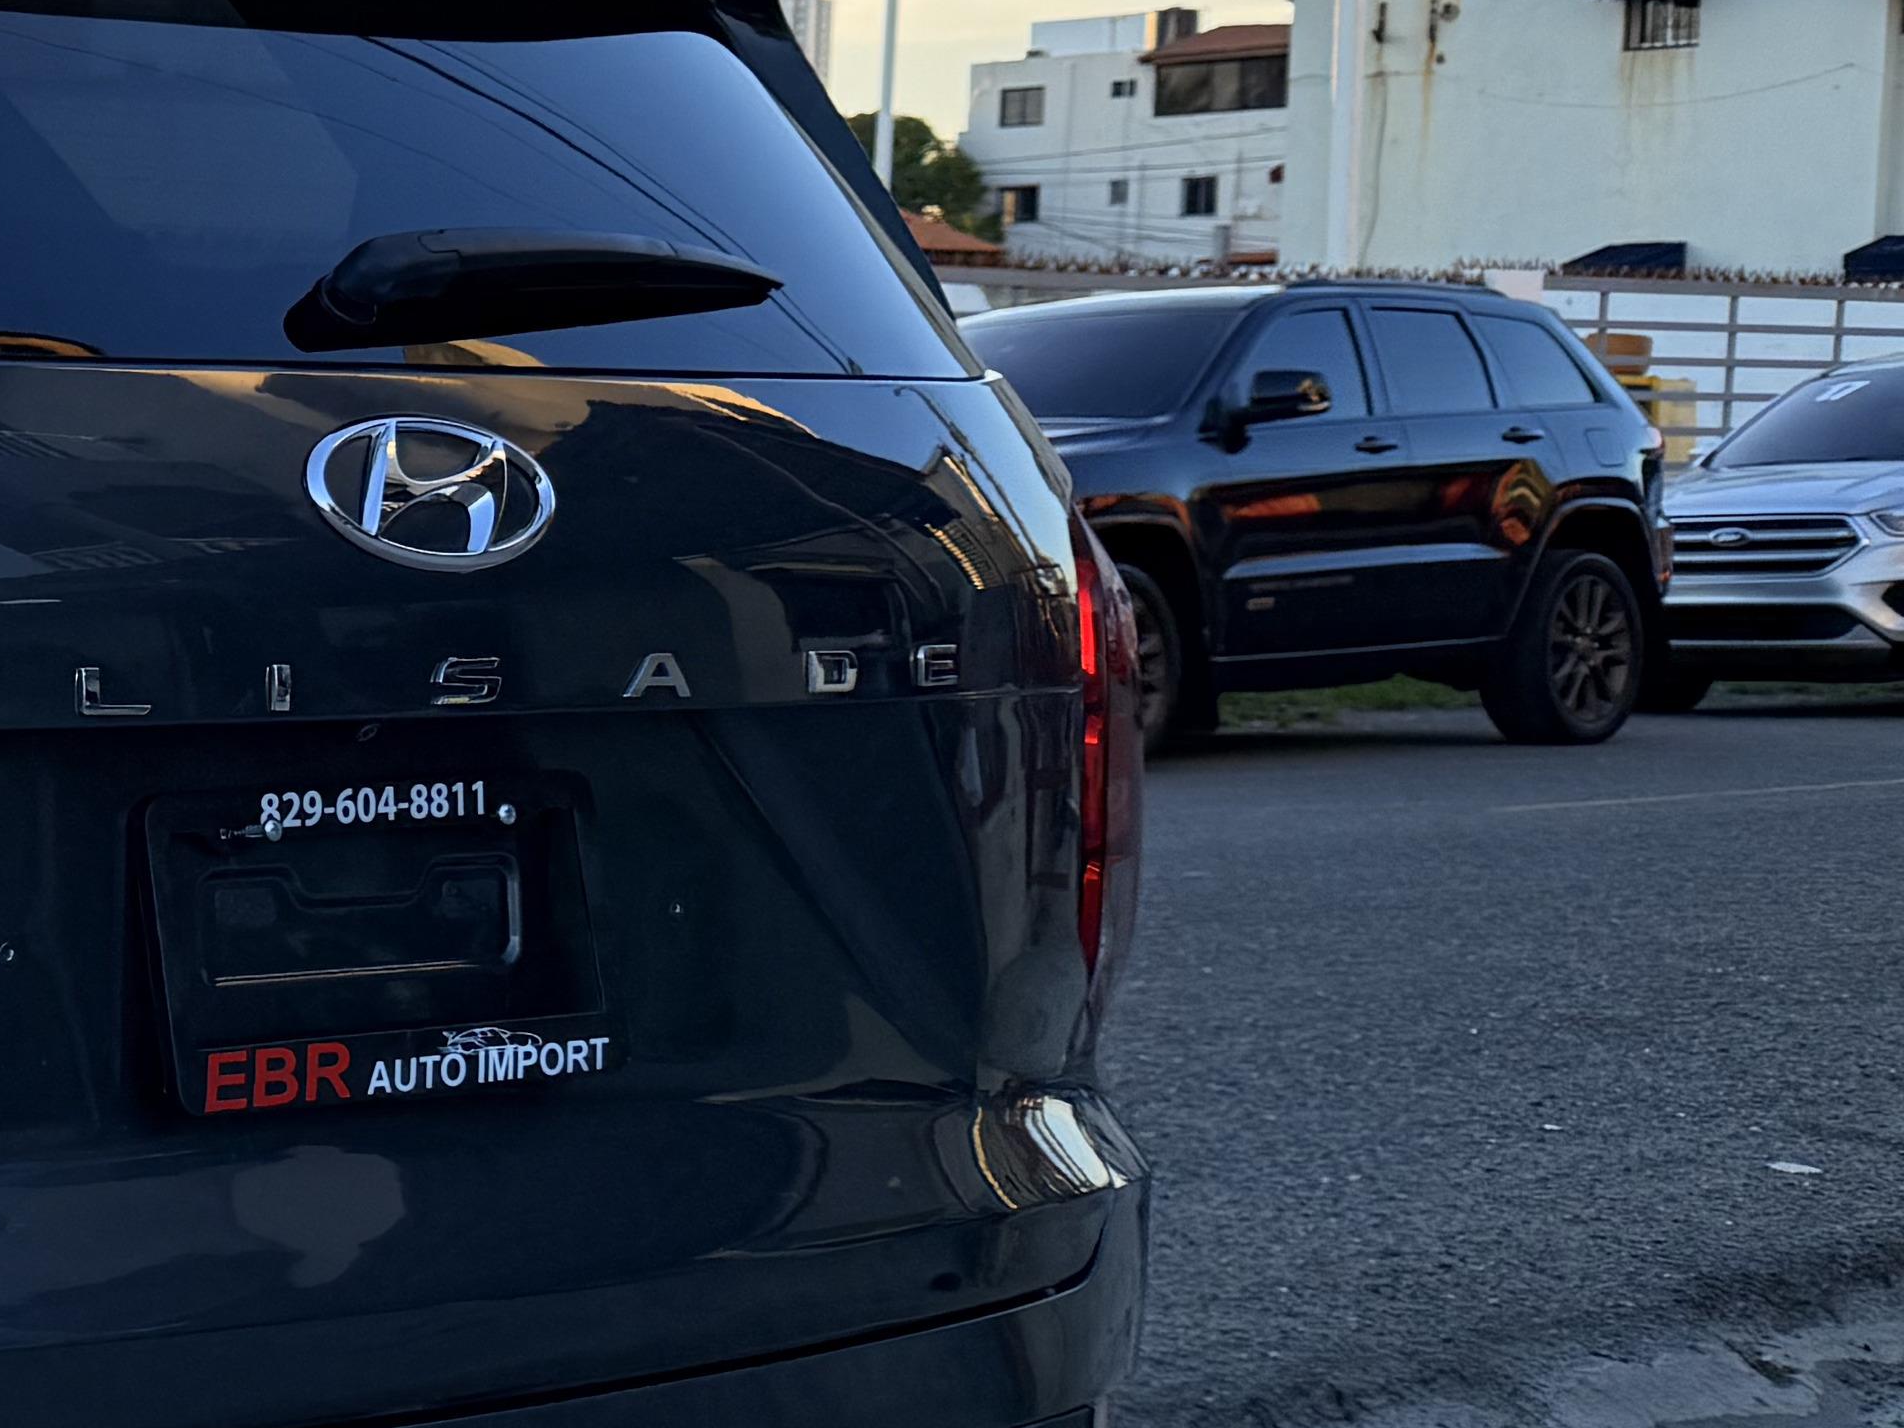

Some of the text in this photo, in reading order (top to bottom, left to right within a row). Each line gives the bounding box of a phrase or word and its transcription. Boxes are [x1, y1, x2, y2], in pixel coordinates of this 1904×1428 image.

[260, 780, 486, 828] 829-604-8811
[204, 1037, 610, 1114] EBR AUTO IMPORT
